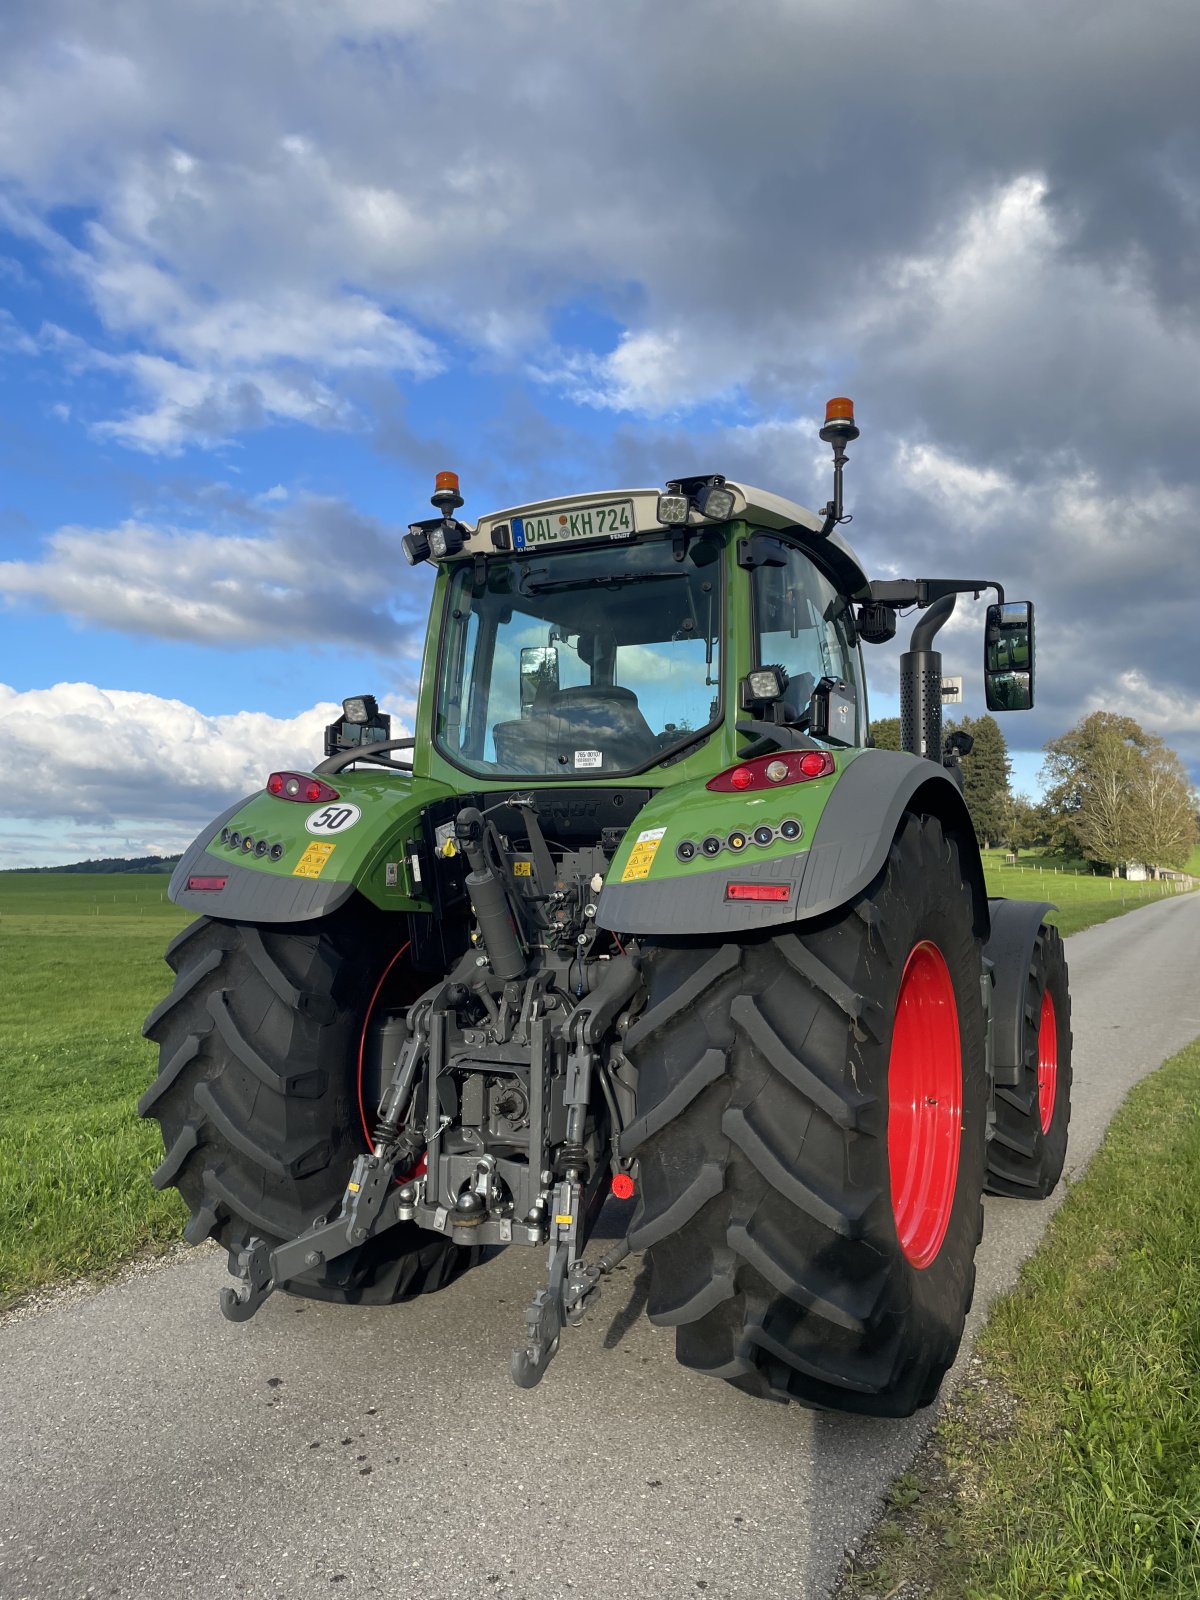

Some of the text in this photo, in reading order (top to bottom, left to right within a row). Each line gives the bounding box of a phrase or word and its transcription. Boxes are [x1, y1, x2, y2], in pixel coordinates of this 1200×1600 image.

[525, 507, 629, 542] OAL KH 724
[610, 532, 631, 540] FENDT
[313, 807, 353, 829] 50
